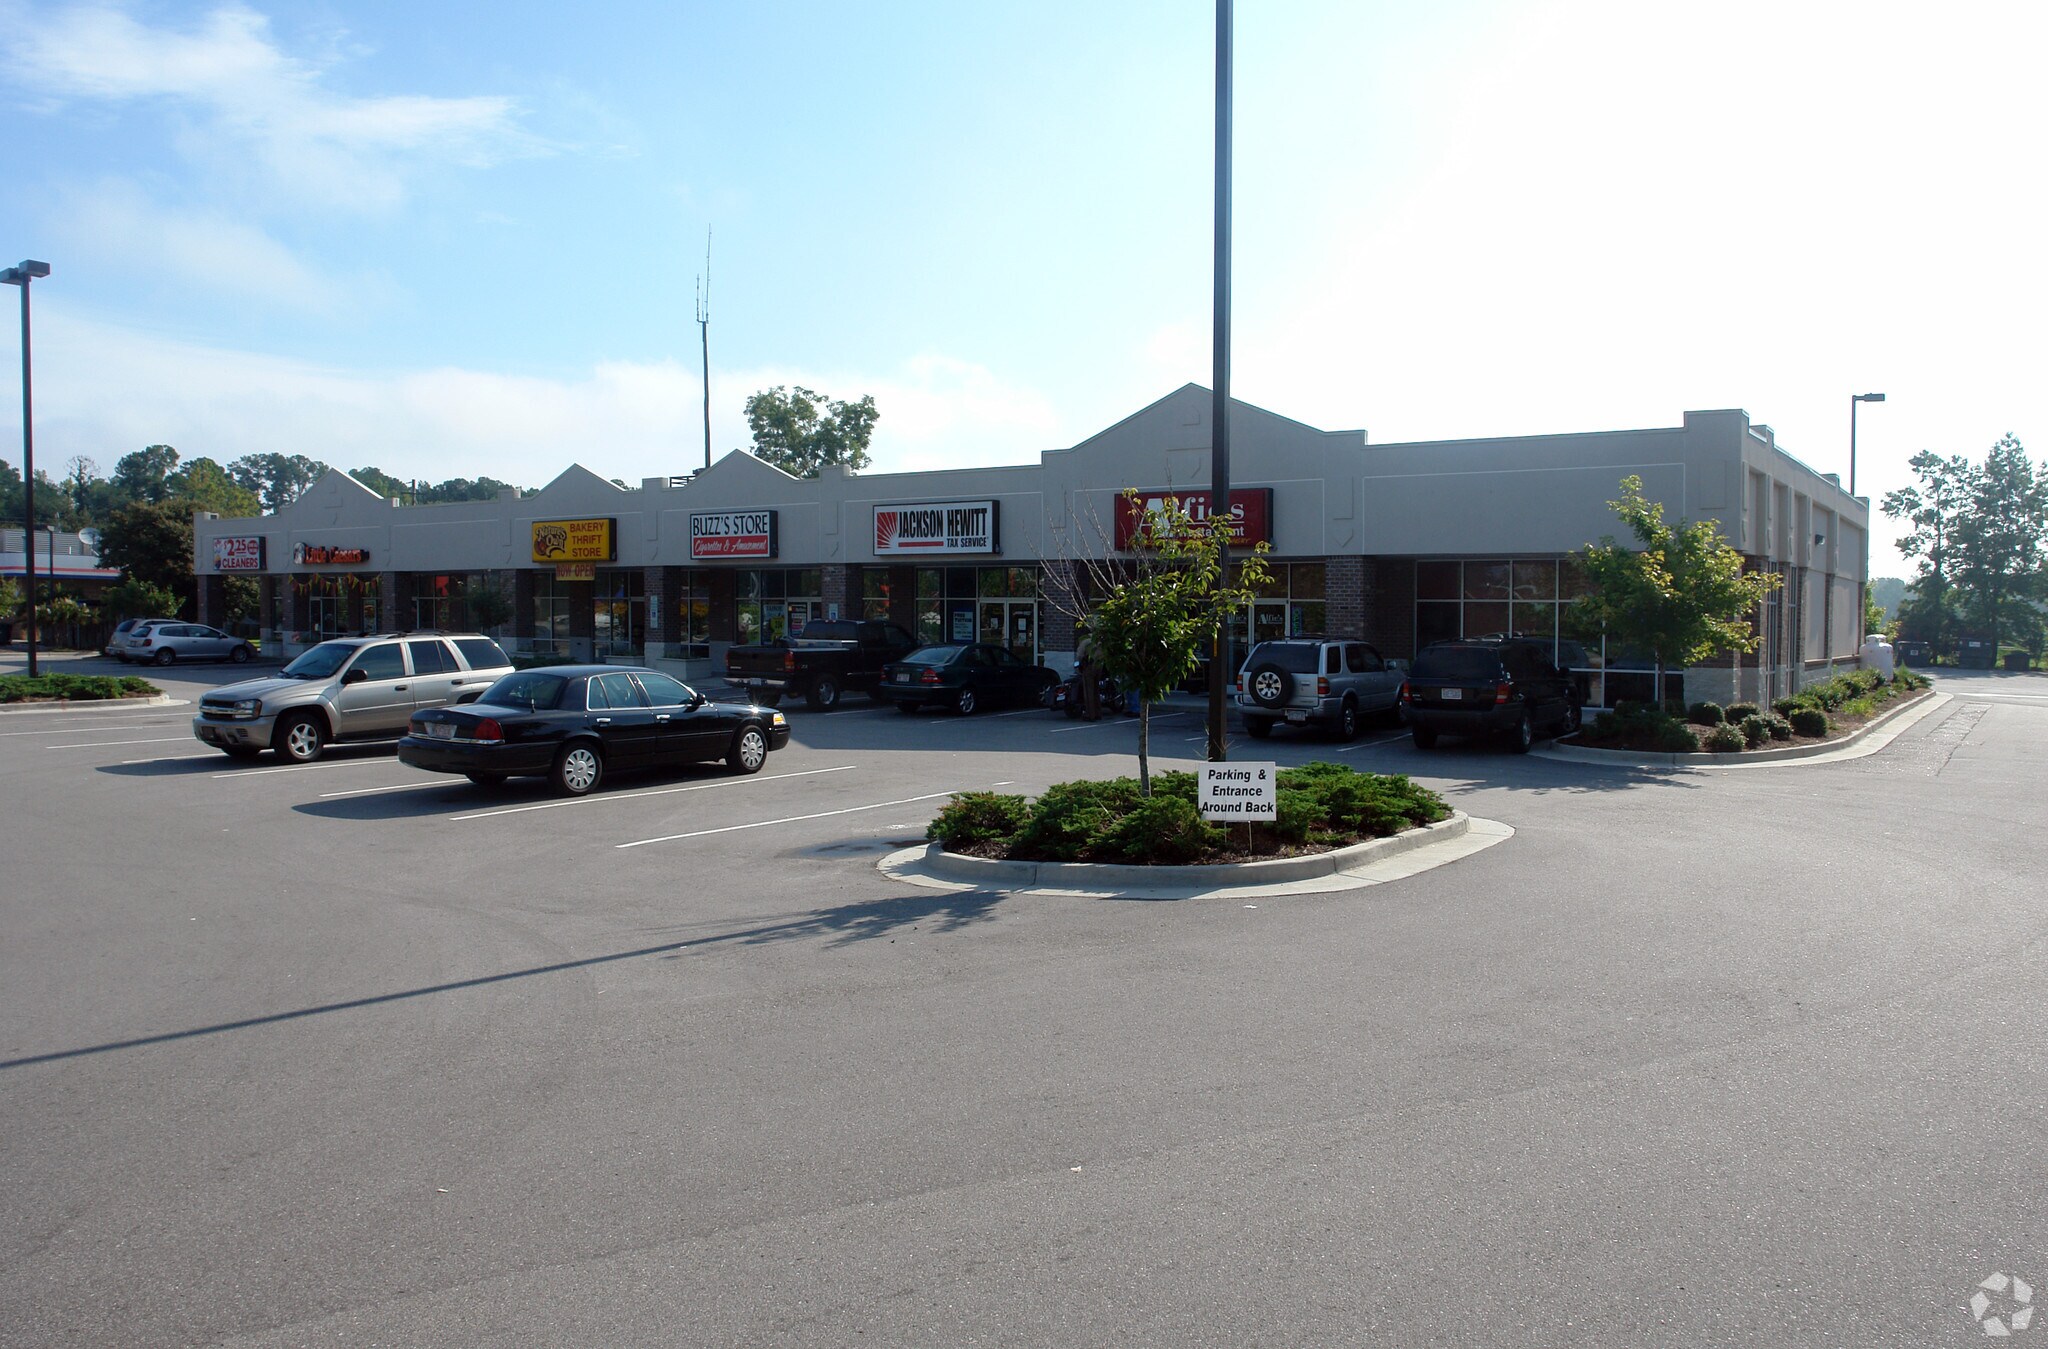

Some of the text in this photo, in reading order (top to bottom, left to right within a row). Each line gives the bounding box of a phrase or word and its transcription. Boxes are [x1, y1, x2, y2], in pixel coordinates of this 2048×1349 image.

[899, 508, 987, 538] JACKSON HEWITT
[1138, 496, 1245, 538] Alfis
[569, 522, 604, 532] BAKERY
[693, 515, 768, 536] BUZZ'S STORE
[572, 534, 602, 545] THRIFT
[723, 539, 730, 551] &
[947, 537, 987, 548] TAX SERVICE
[305, 545, 326, 564] Little
[572, 547, 602, 557] STORE
[222, 557, 258, 568] CLEANERS
[556, 564, 594, 577] NOW OPEN
[1208, 768, 1266, 783] Parking &
[1212, 785, 1263, 797] Entrance
[1201, 801, 1274, 813] Around Back
